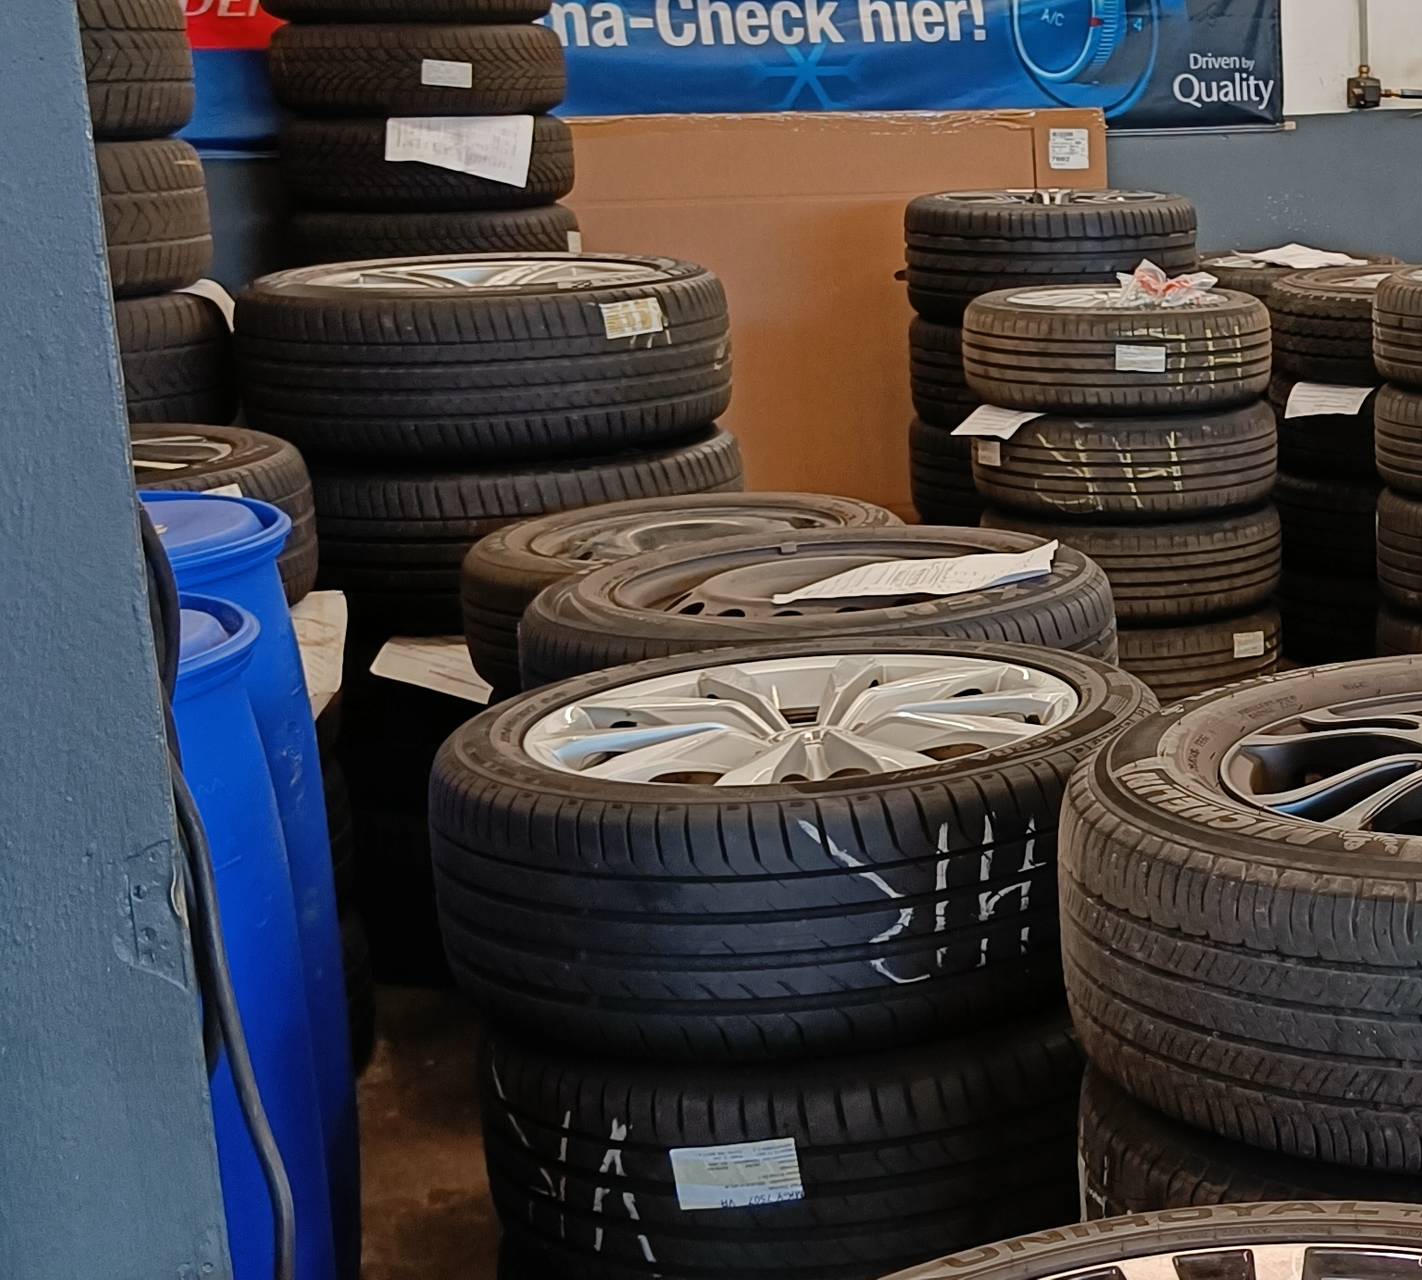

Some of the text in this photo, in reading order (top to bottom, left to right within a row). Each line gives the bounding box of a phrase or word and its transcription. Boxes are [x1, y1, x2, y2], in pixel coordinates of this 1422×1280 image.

[858, 0, 987, 43] hier!
[1040, 9, 1065, 27] A/C
[1132, 18, 1143, 32] 4
[1189, 53, 1255, 71] Driven by
[1173, 73, 1274, 109] Quality
[1116, 771, 1344, 846] MICHELIN
[941, 1202, 1380, 1268] UNIROYAL
